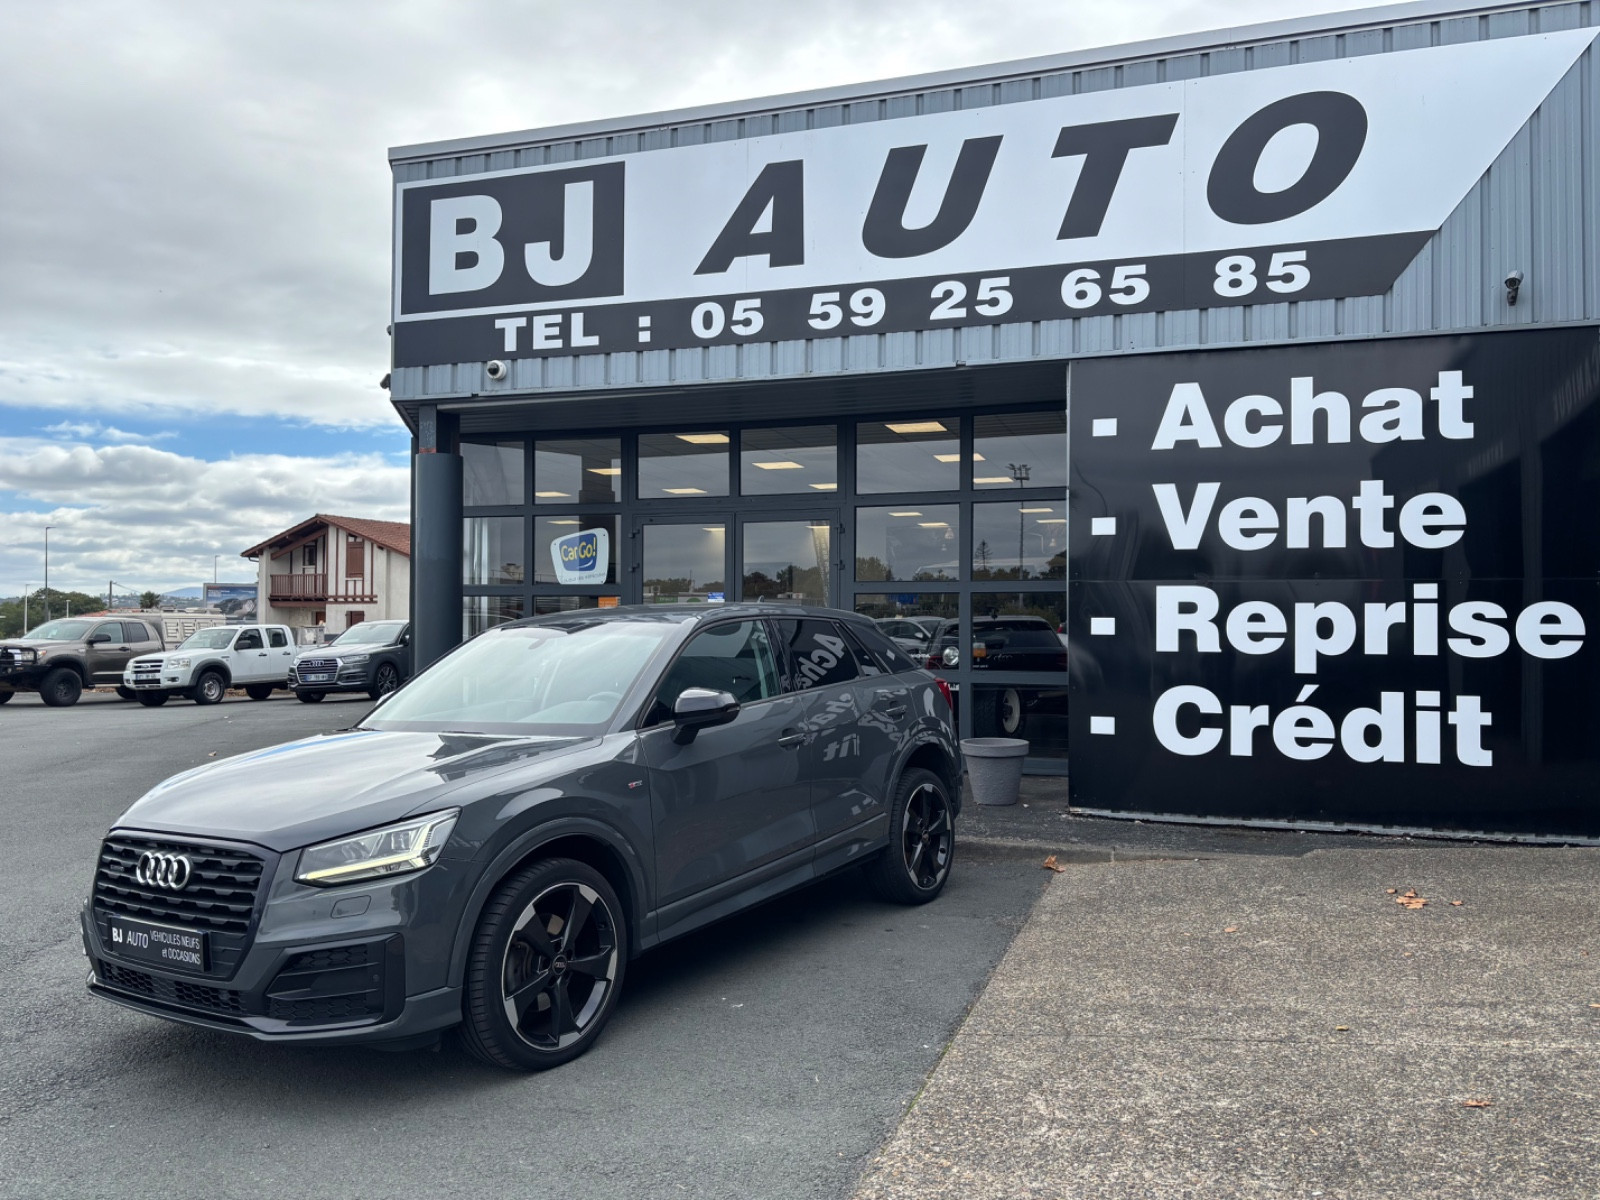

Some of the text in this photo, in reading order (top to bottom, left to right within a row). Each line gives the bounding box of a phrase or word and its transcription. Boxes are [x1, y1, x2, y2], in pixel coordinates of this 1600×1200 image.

[429, 90, 1369, 296] BJ AUTO
[495, 312, 600, 352] TEL
[690, 298, 764, 339] 05
[808, 287, 885, 331] 59
[930, 276, 1014, 321] 25
[1061, 263, 1151, 309] 65
[1213, 250, 1310, 298] 85
[1151, 369, 1475, 451] Achat
[1152, 479, 1467, 550] Vente
[1156, 582, 1586, 675] Reprise
[1153, 684, 1493, 767] Crédit
[111, 927, 149, 949] BJ AUTO
[168, 948, 201, 965] OCCASIONS
[181, 936, 200, 950] NEUFS
